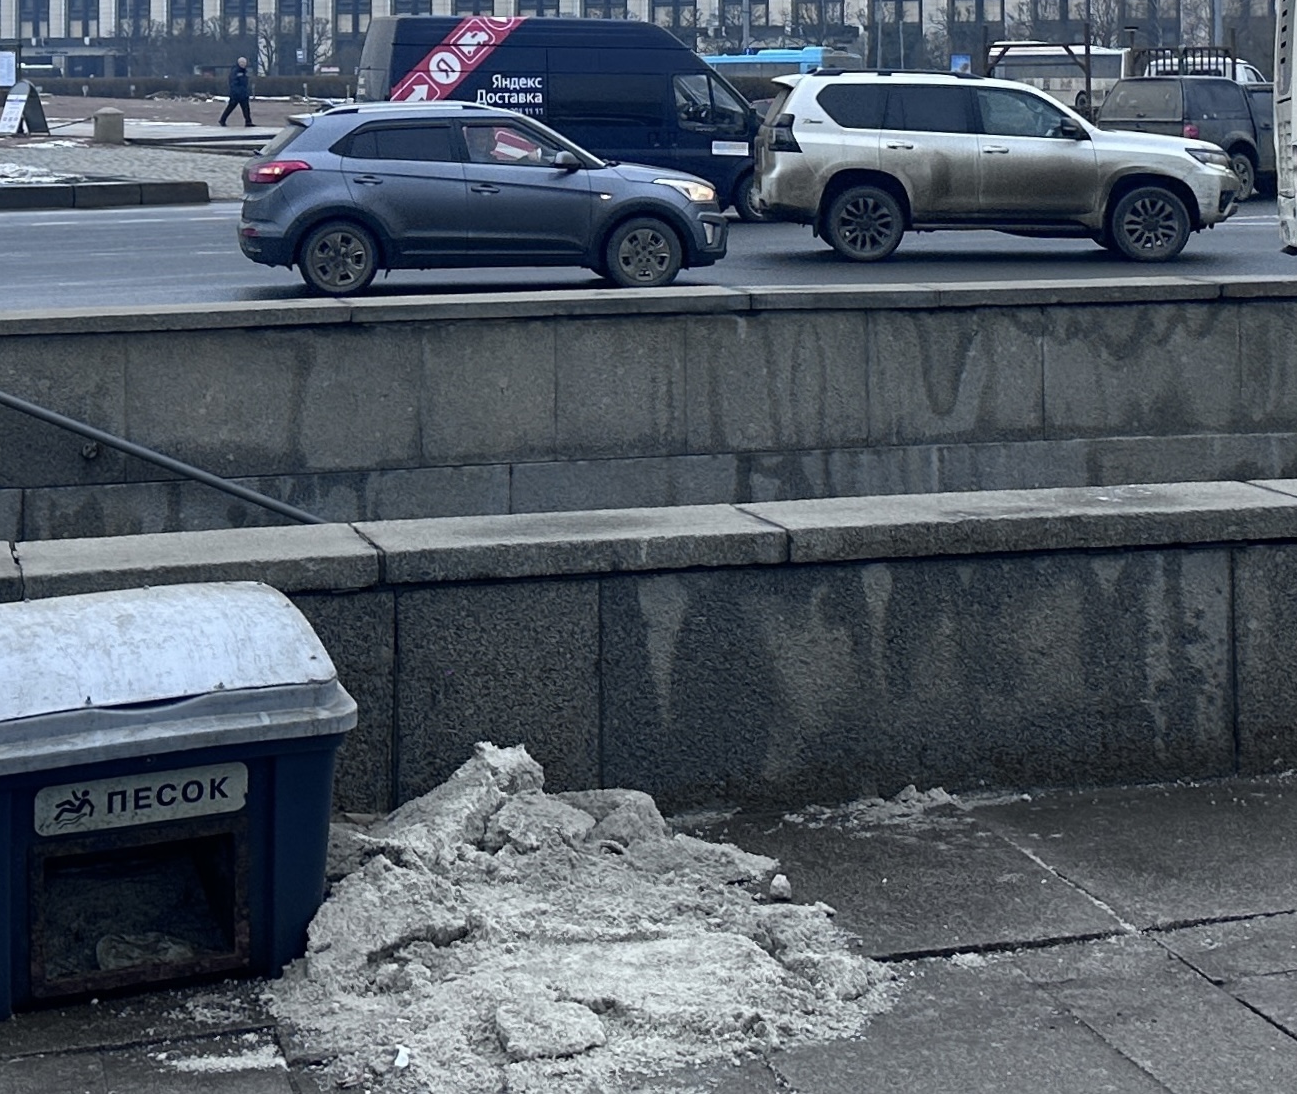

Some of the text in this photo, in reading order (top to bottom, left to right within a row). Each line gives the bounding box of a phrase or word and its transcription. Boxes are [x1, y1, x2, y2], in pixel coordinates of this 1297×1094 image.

[492, 74, 543, 90] Яндекс
[476, 89, 543, 106] Доставка
[106, 776, 229, 814] ПЕСОК
